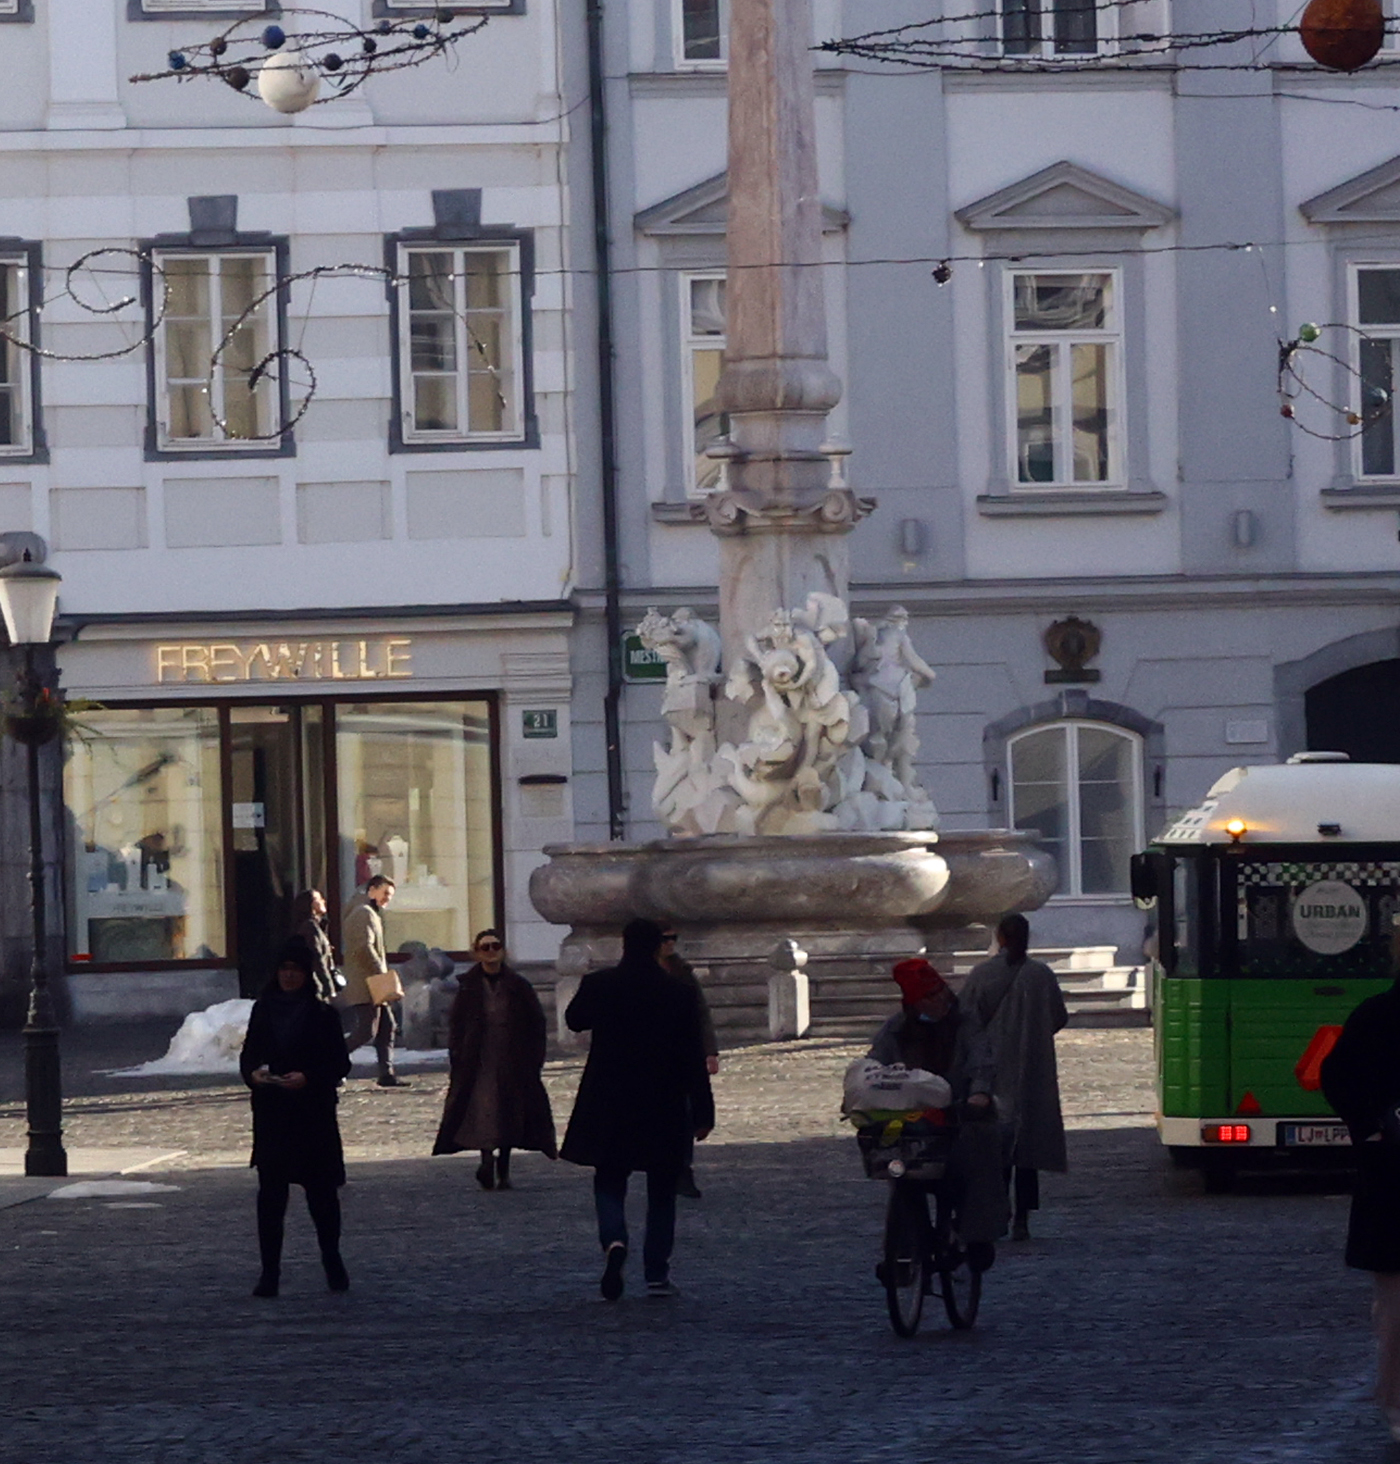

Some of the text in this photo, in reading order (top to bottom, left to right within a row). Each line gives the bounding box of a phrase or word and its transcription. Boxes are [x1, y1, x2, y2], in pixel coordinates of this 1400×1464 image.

[157, 640, 413, 682] FREYWILLE
[533, 713, 548, 727] 21
[1301, 904, 1360, 918] URBAN
